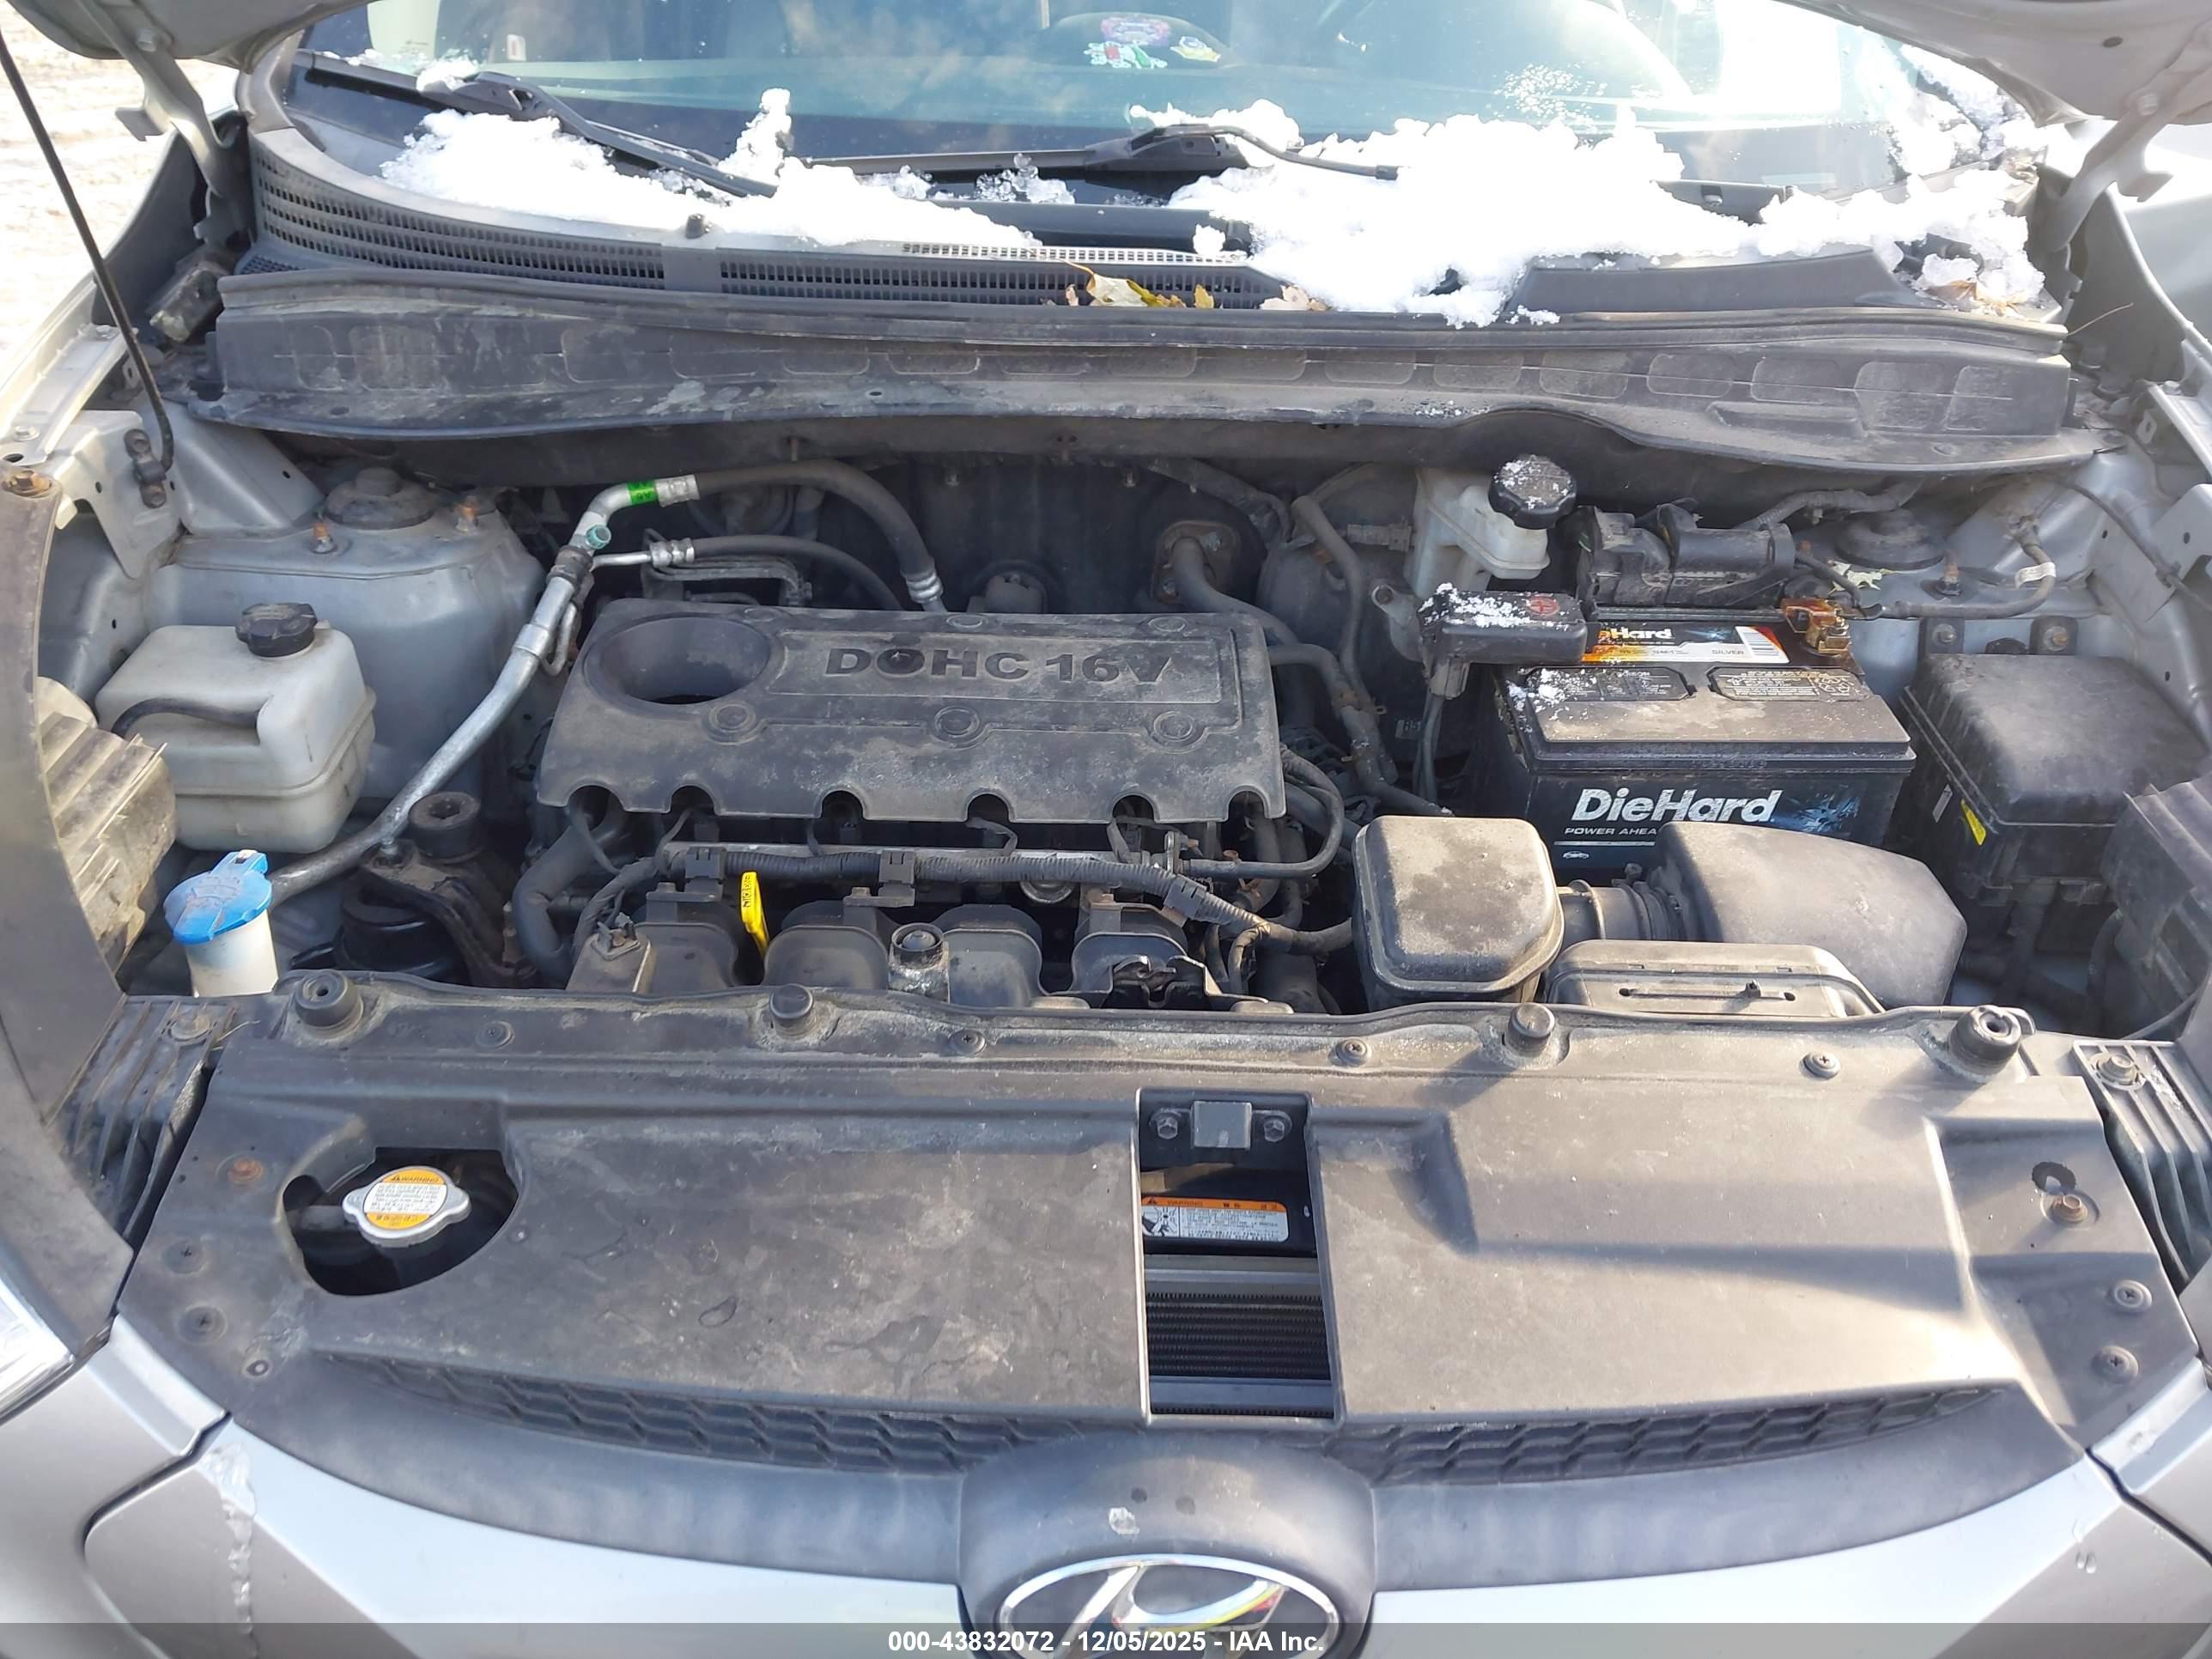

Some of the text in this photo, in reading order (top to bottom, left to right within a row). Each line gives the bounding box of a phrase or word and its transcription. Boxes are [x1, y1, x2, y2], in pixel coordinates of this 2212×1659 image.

[825, 647, 1171, 683] DOHC 16V
[1571, 787, 1783, 823] DieHard
[1565, 827, 1657, 836] POWER AHEA
